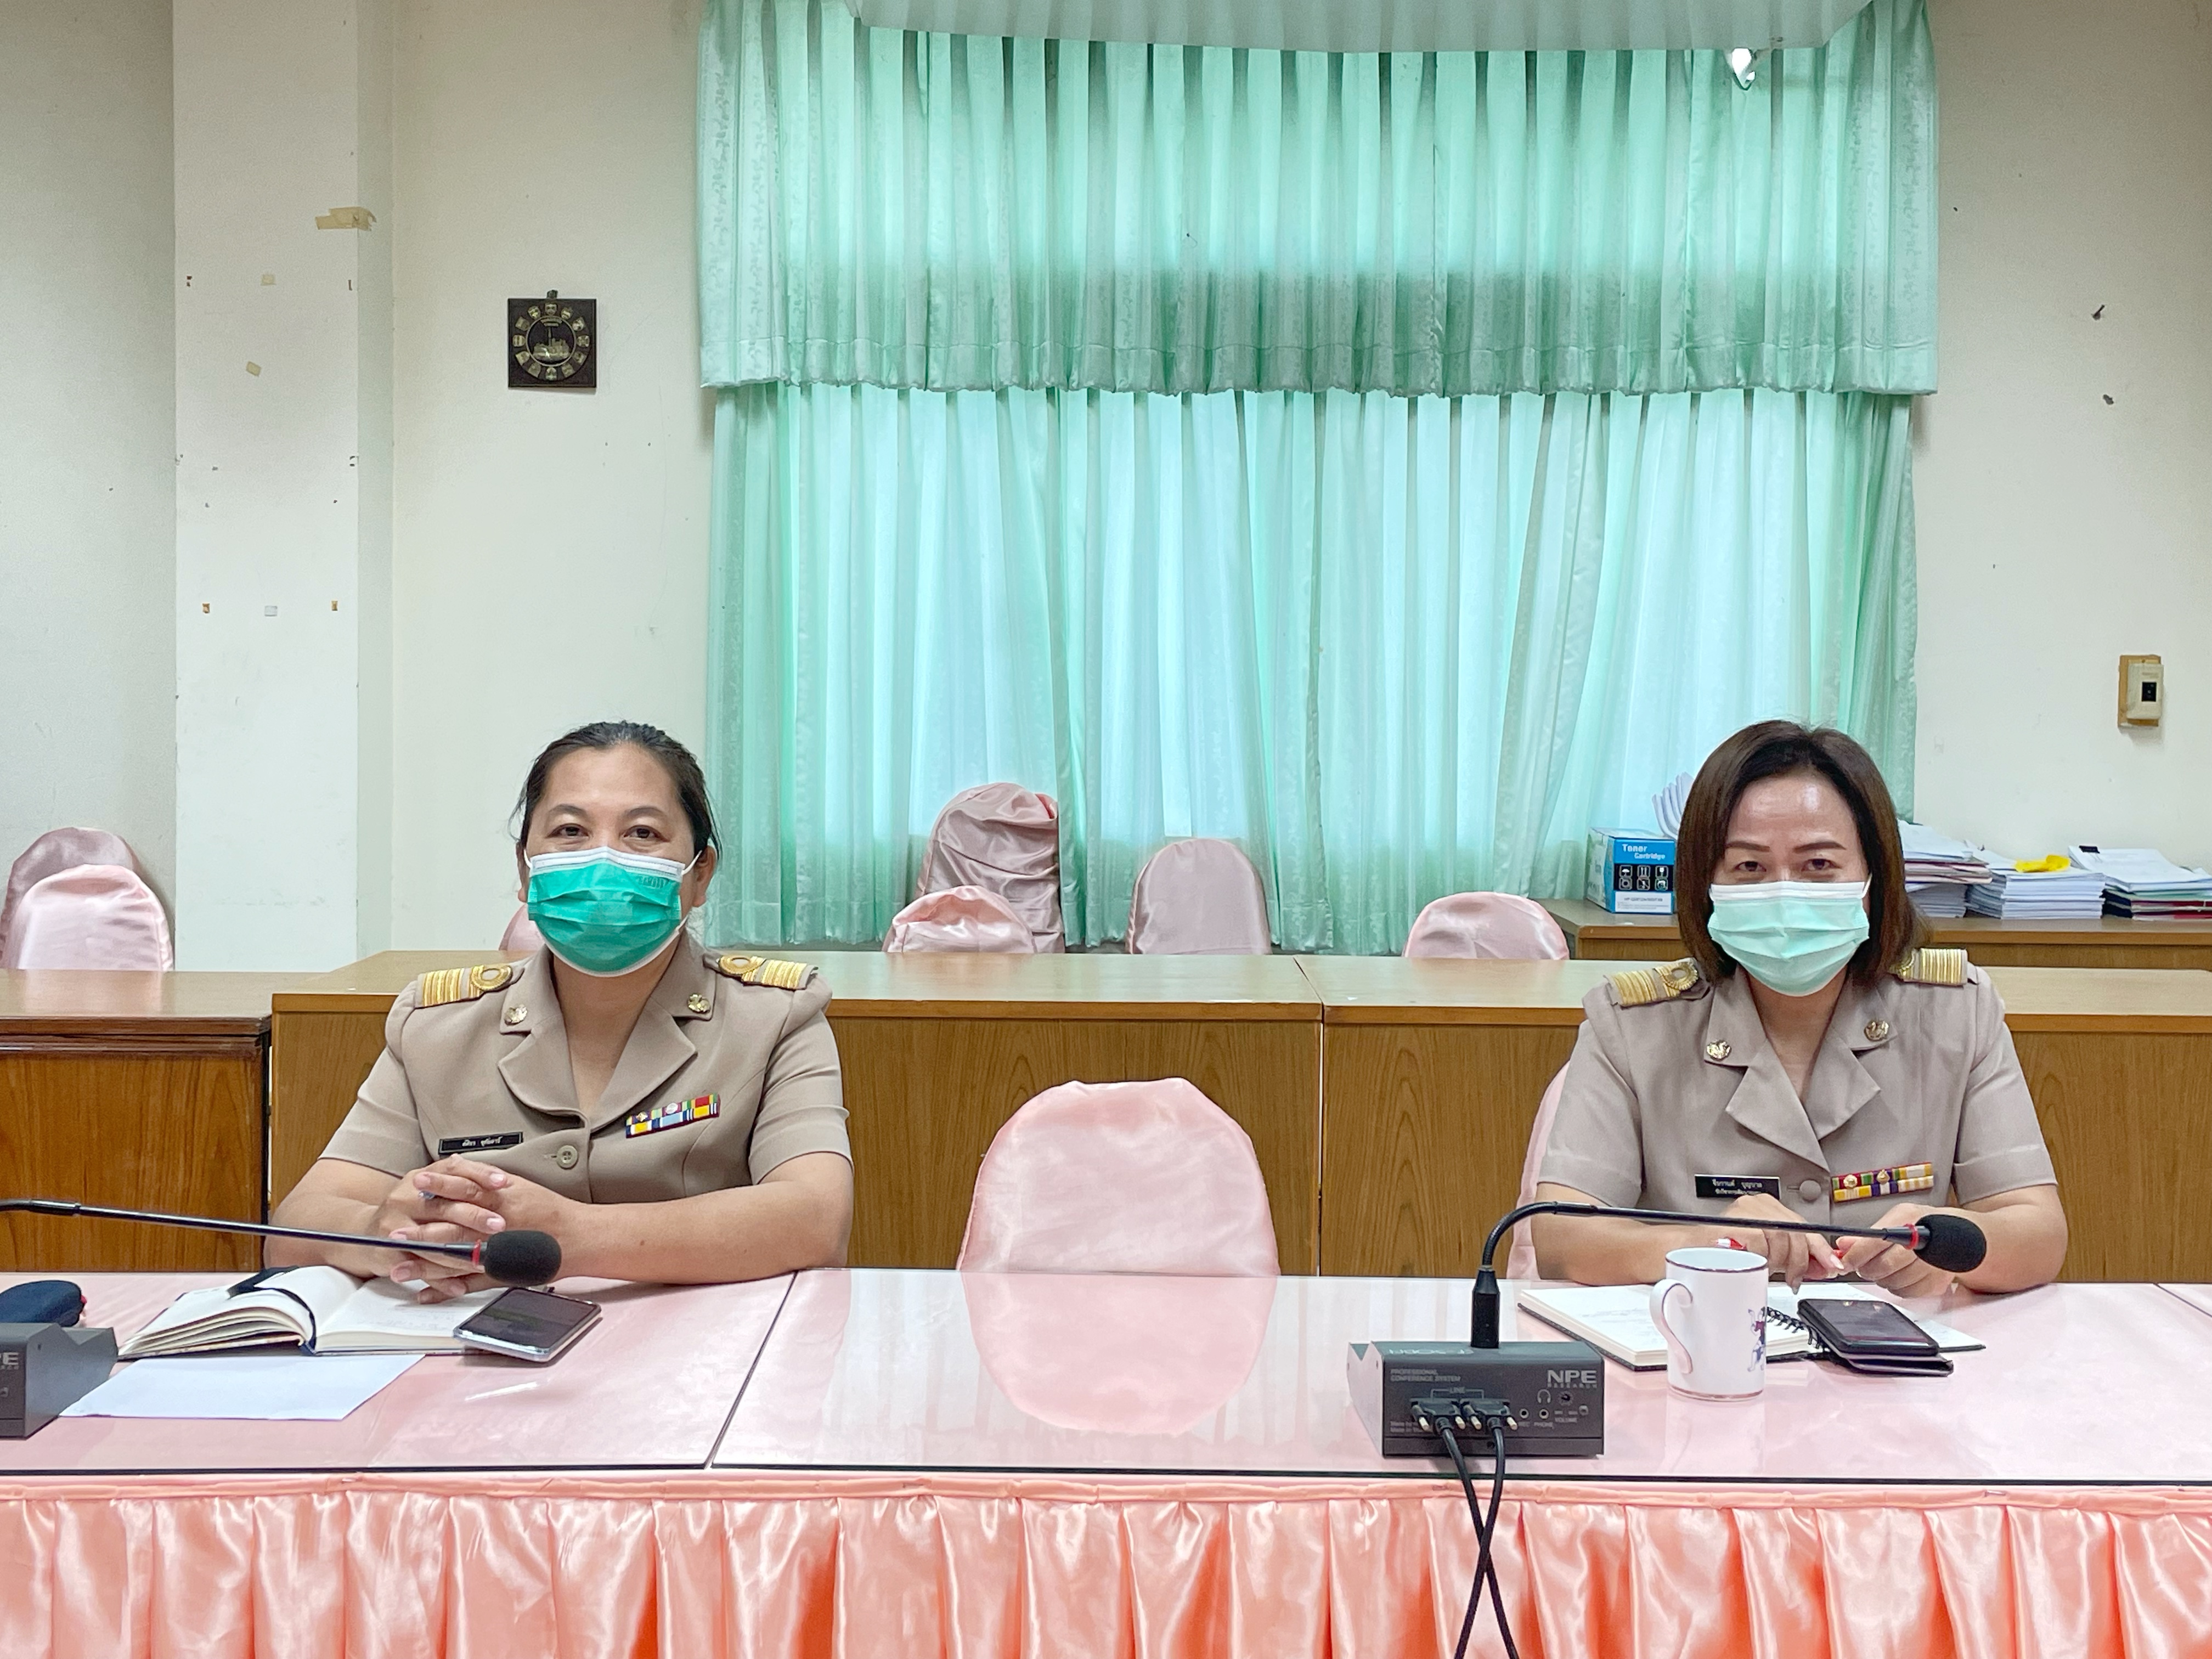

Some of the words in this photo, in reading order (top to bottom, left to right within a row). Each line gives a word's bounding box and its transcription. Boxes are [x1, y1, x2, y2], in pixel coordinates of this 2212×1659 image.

[1622, 844, 1647, 852] Toner
[0, 1352, 19, 1365] E
[1547, 1370, 1597, 1384] NPE
